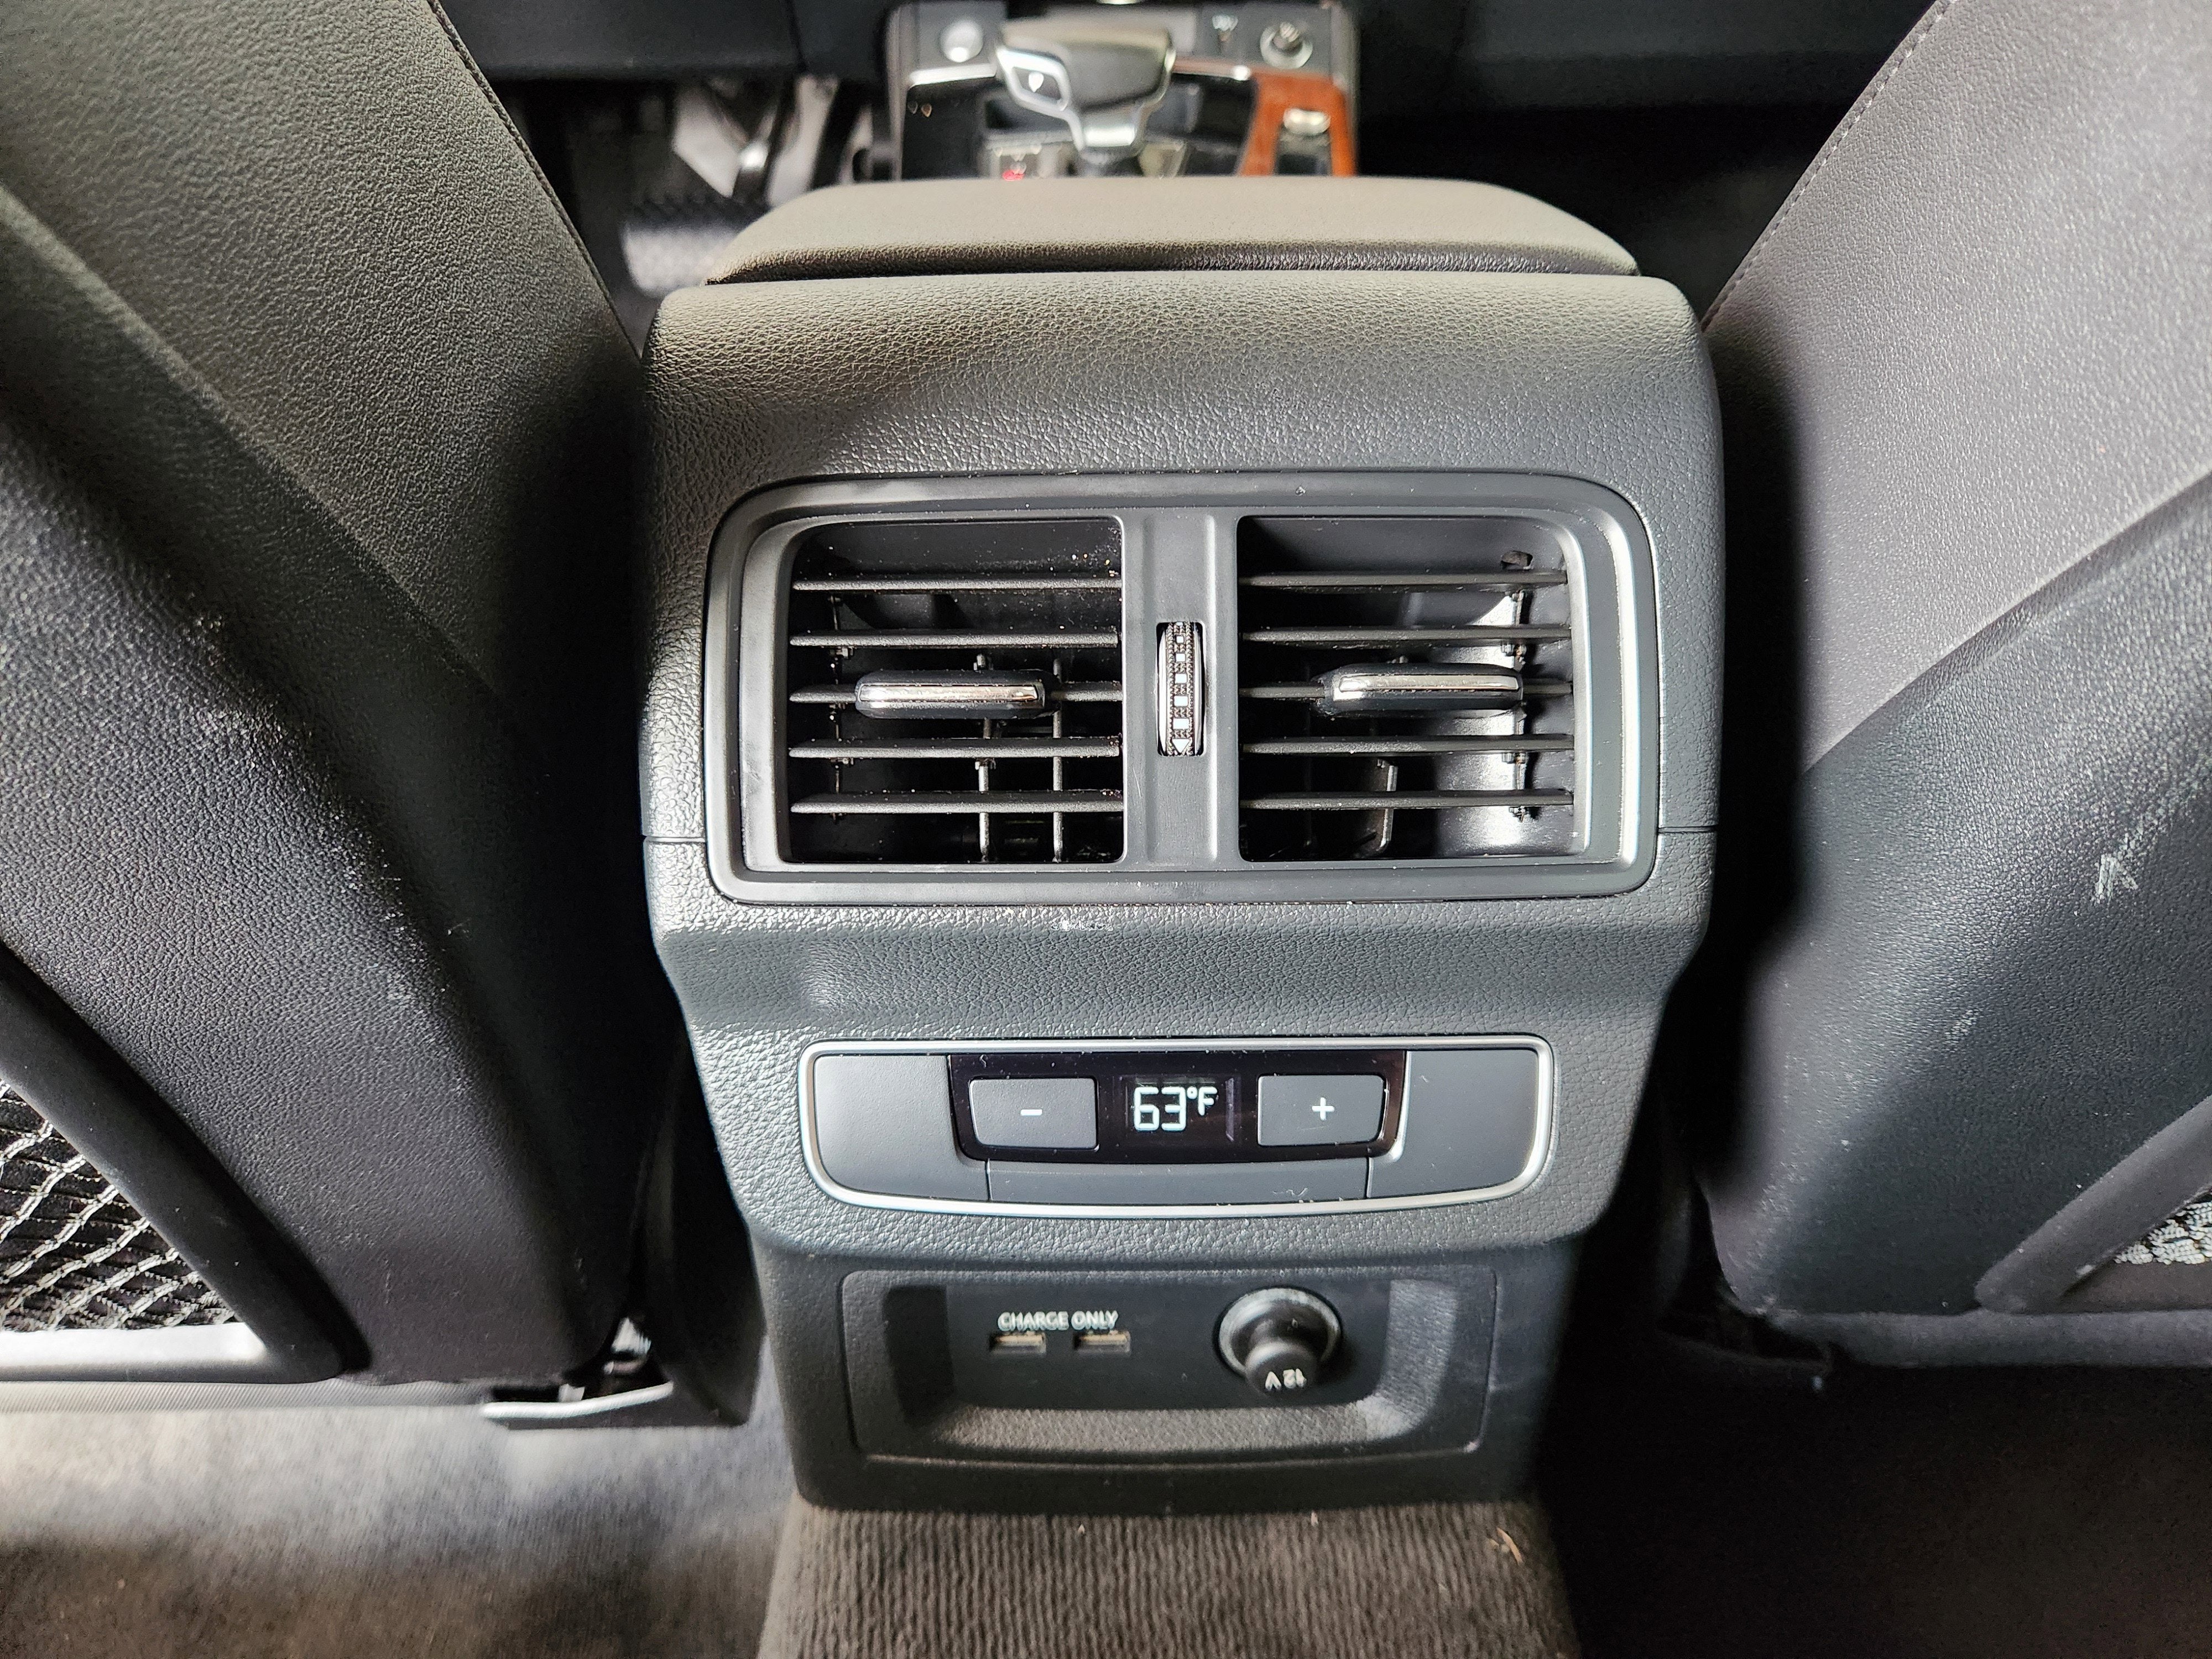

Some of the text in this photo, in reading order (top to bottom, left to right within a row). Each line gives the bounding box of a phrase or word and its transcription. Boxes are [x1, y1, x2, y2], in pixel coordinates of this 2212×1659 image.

[1134, 1087, 1218, 1131] 63°F
[997, 1310, 1119, 1331] CHARGE ONLY
